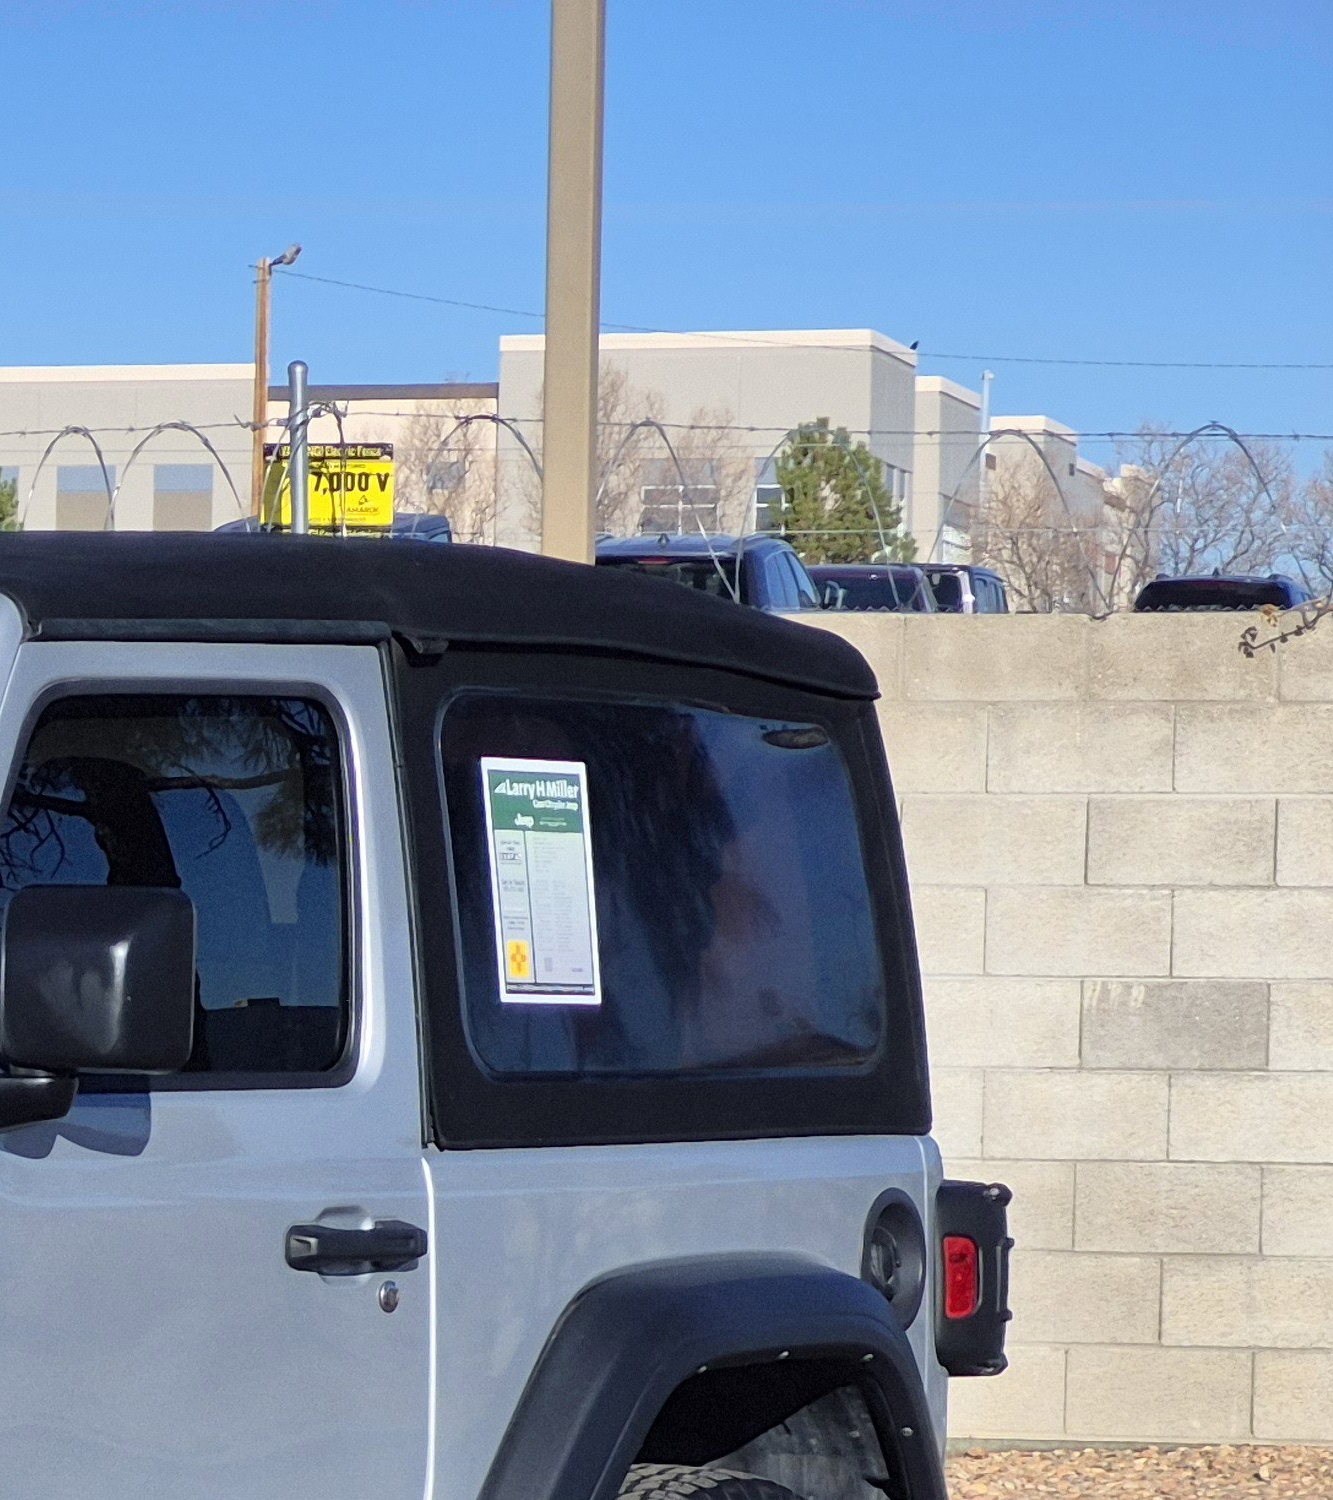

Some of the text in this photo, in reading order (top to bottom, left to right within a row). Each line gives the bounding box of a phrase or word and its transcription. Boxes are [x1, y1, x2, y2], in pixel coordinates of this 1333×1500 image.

[311, 472, 390, 495] 7,000 V
[505, 778, 579, 800] Larry H Miller
